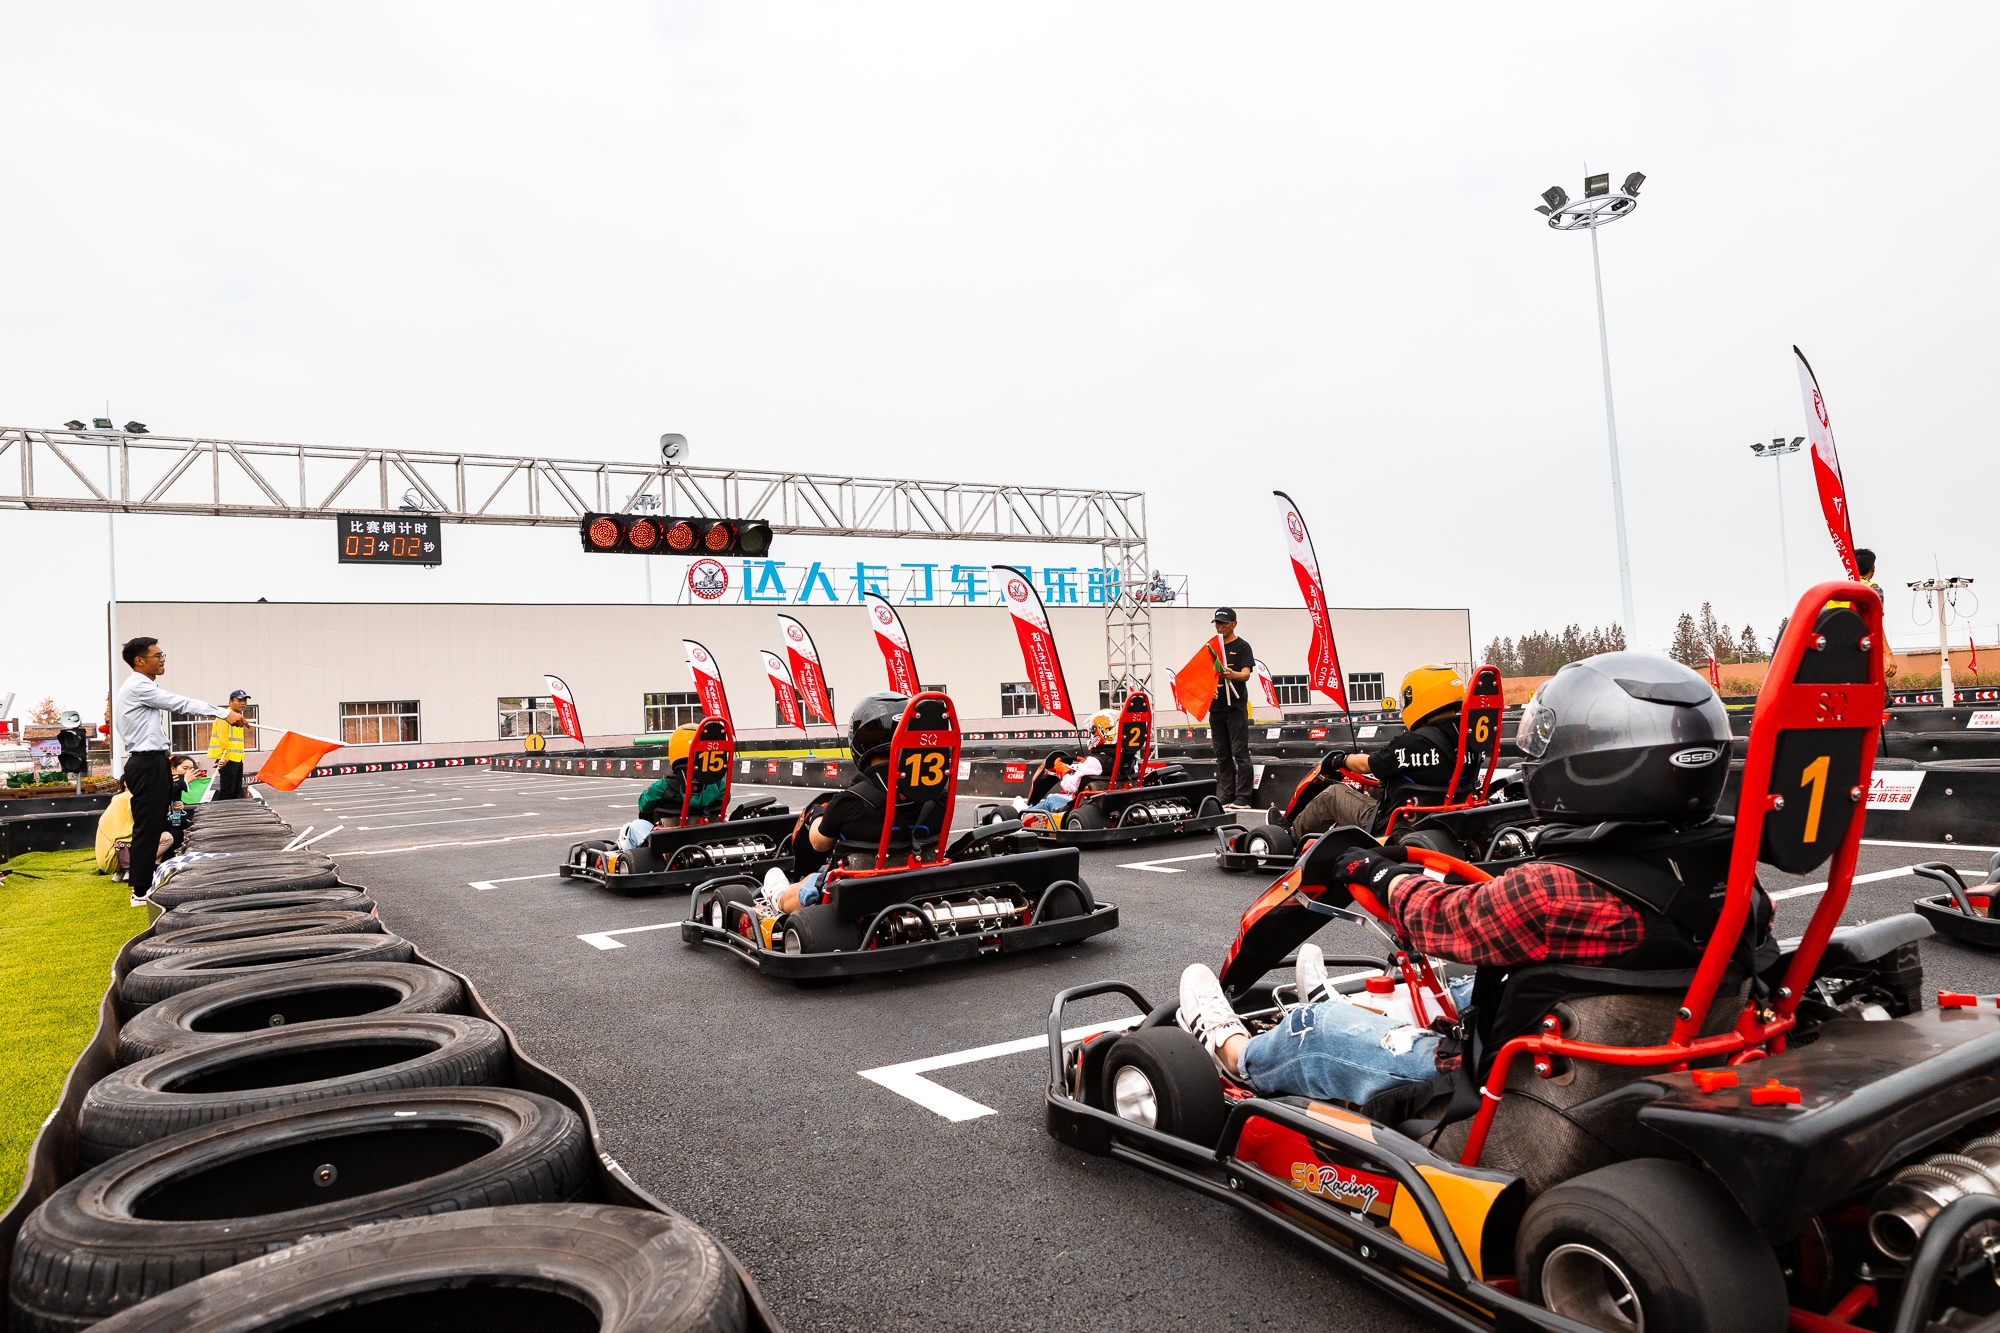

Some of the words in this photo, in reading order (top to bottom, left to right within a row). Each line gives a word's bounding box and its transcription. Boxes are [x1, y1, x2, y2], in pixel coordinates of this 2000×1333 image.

[350, 520, 428, 535] 比赛倒计时
[742, 559, 1122, 603] 达人卡丁车乐部
[1817, 692, 1847, 722] SQ
[920, 733, 938, 746] SQ
[1128, 727, 1141, 747] 2
[1475, 715, 1489, 743] 6
[532, 737, 538, 750] 1
[707, 742, 719, 750] SQ
[698, 750, 724, 773] 15
[1394, 747, 1440, 769] Luck
[1678, 751, 1713, 764] GSB
[905, 752, 945, 787] 13
[1800, 756, 1831, 843] 1
